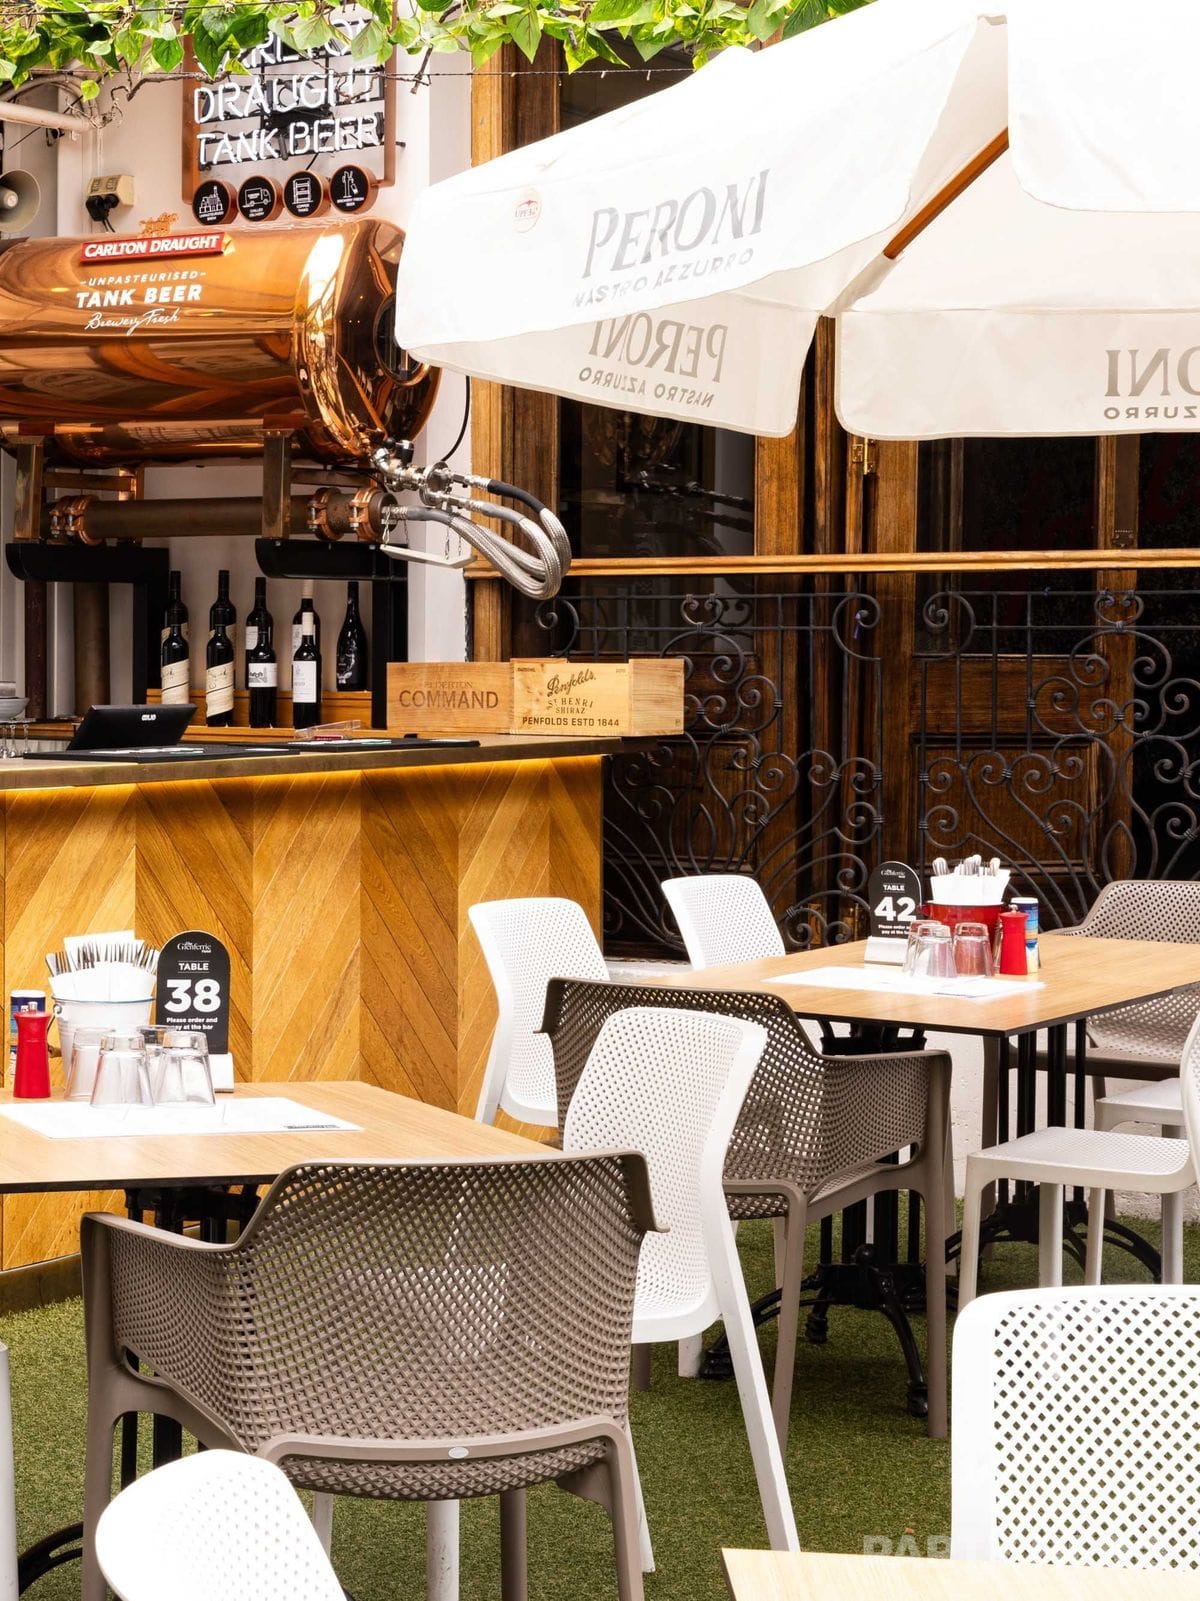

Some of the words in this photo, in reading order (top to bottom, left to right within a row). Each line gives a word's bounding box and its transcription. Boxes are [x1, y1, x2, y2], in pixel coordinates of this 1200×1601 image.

[197, 128, 279, 165] TANK
[288, 115, 381, 154] BEER
[582, 168, 770, 279] PERONI
[84, 241, 147, 257] CARLTON
[150, 235, 220, 253] DRAUGHT
[571, 275, 648, 307] NASTRO
[652, 247, 754, 290] AZZURRO
[76, 289, 136, 308] TANK
[144, 284, 203, 304] BEER
[84, 311, 146, 336] Brewery
[142, 307, 181, 326] Fresh
[399, 689, 499, 708] COMMAND
[561, 697, 594, 708] HENRI
[522, 716, 569, 725] PENFOLDS
[597, 718, 620, 726] 1844
[874, 896, 917, 921] 42
[178, 963, 209, 971] TABLE
[164, 978, 221, 1013] 38
